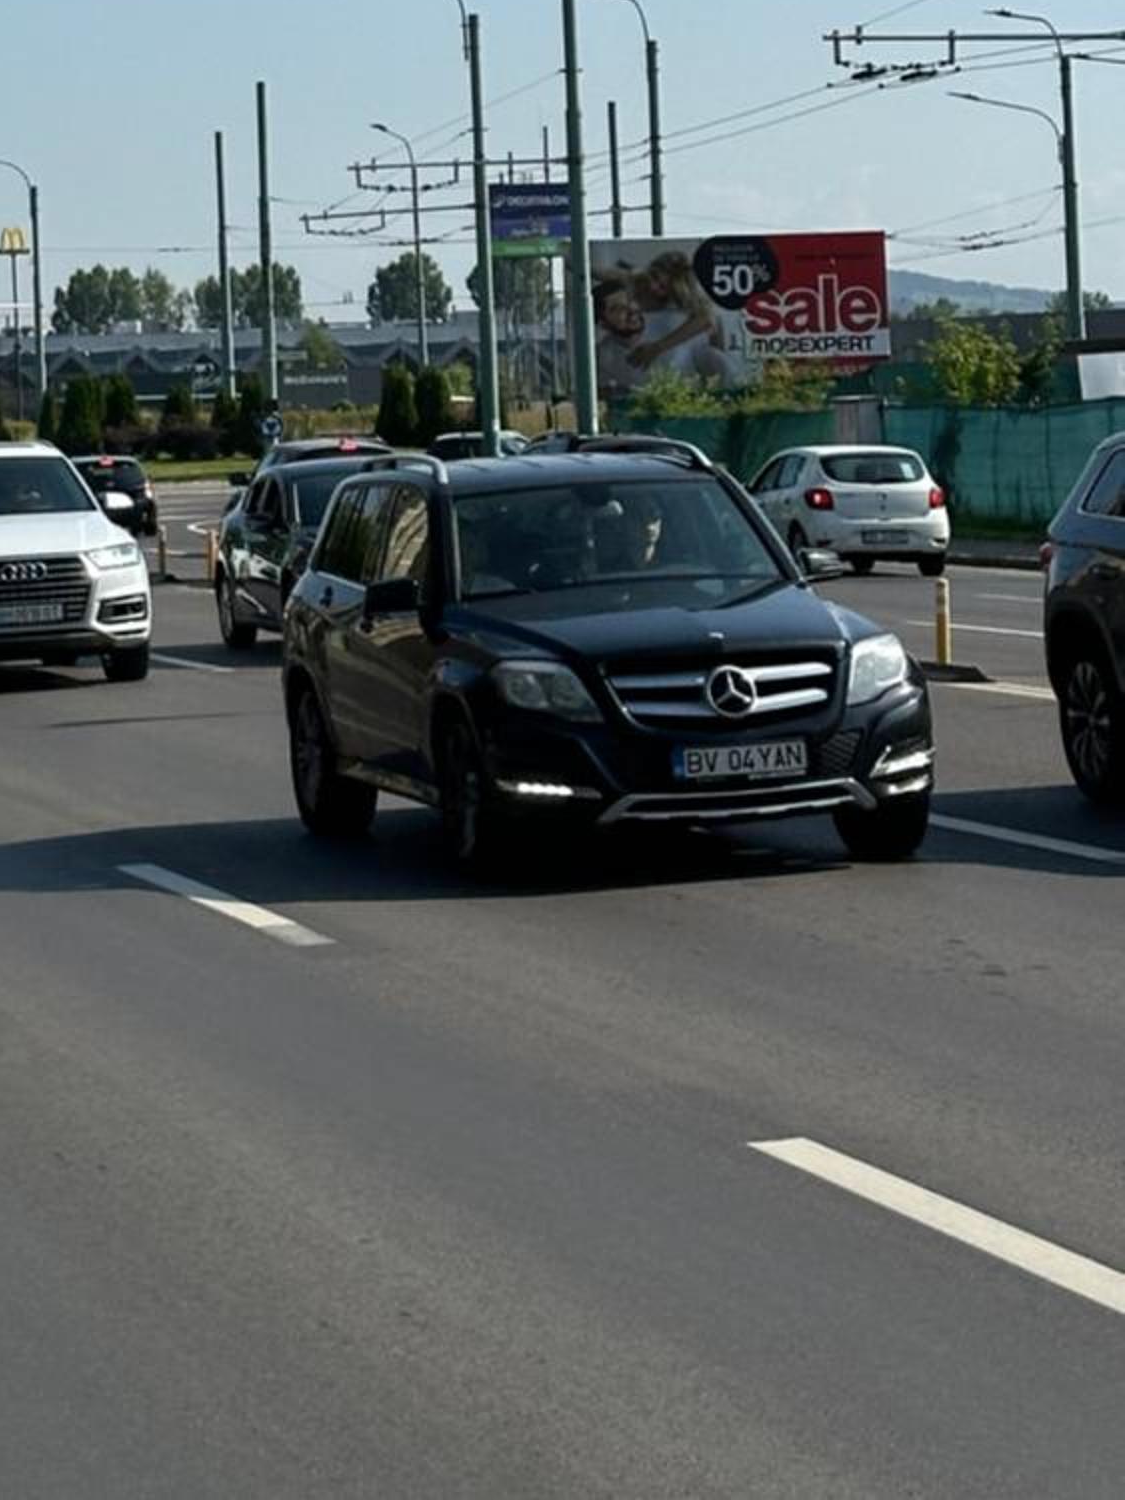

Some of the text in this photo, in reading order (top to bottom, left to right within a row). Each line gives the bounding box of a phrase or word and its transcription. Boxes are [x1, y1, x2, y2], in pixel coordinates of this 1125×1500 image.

[712, 262, 772, 297] 50%
[744, 273, 881, 336] sale
[687, 751, 718, 774] BV
